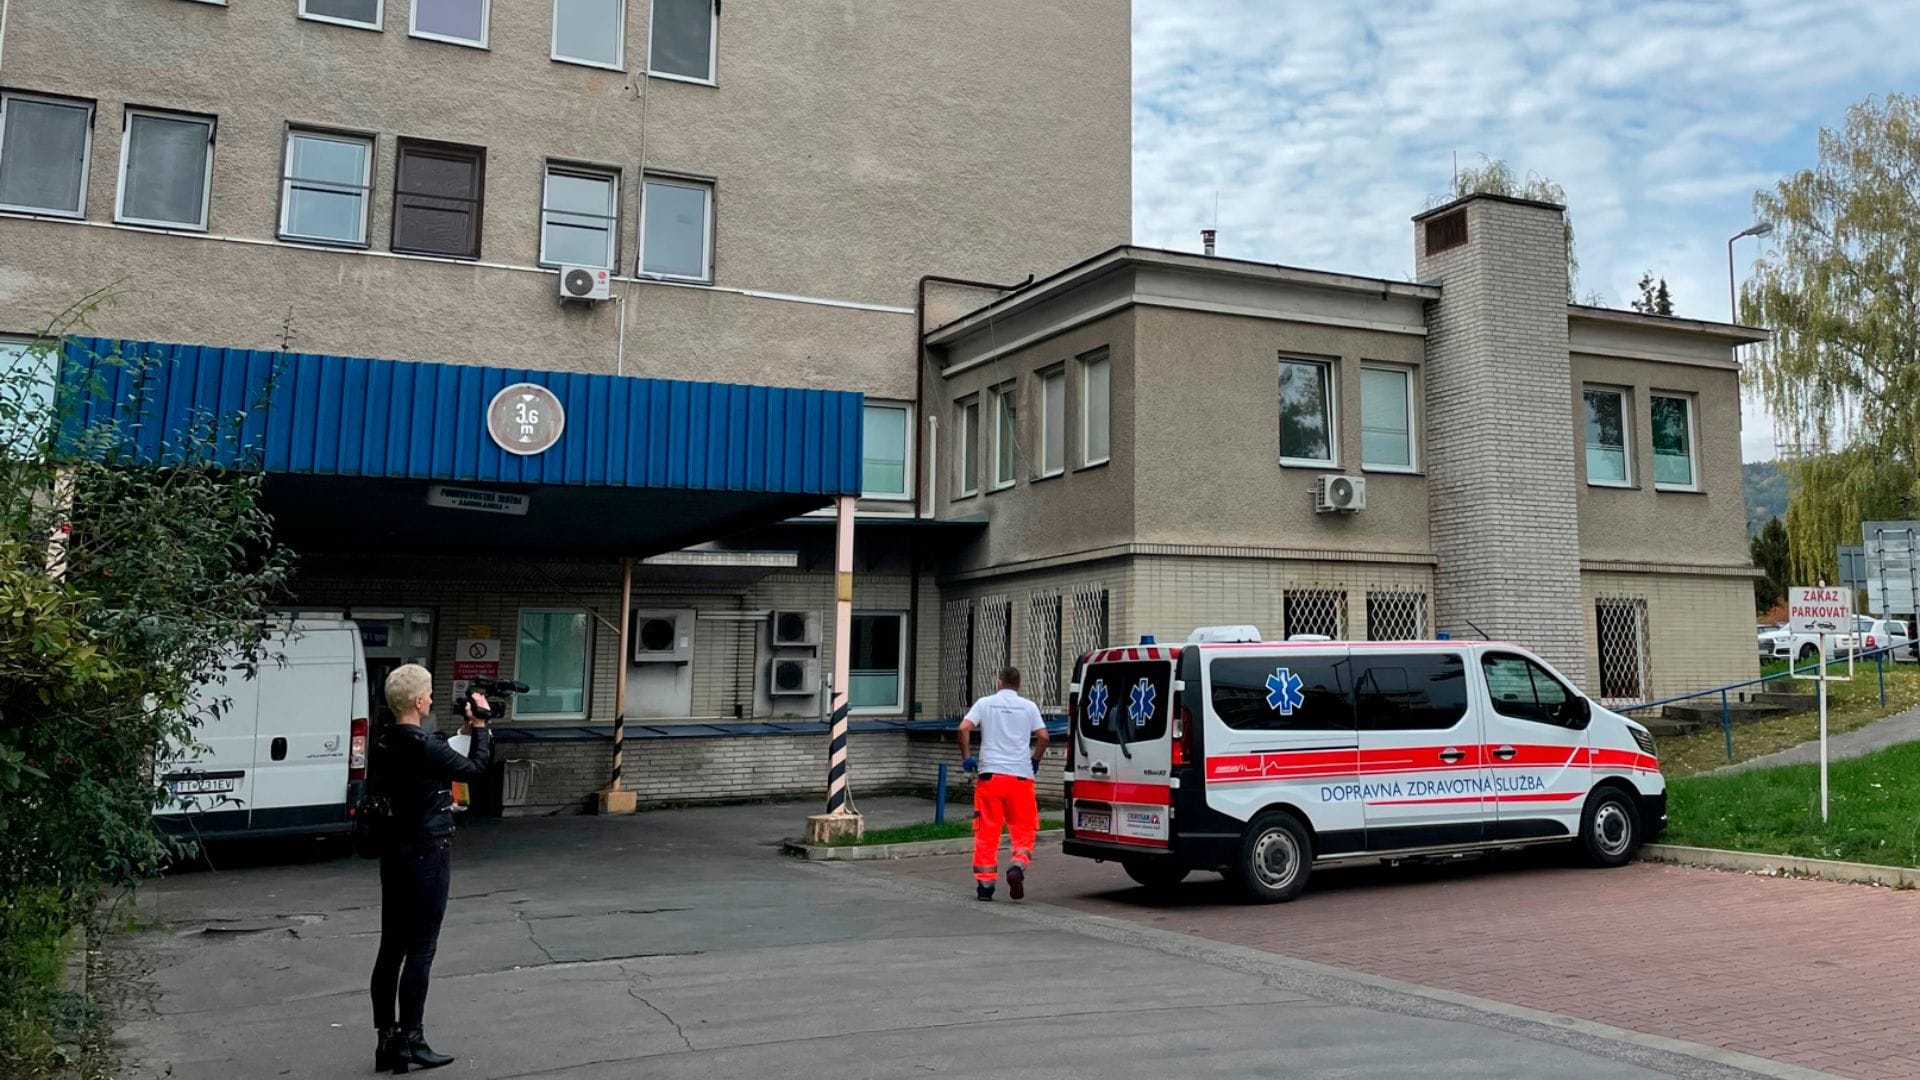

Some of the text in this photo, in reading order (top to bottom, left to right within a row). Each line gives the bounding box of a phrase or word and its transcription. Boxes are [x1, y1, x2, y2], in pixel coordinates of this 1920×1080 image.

[520, 425, 534, 434] m
[1321, 775, 1546, 802] DOPRAVNÁ ZDRAVOTNÁ SLUŽBA
